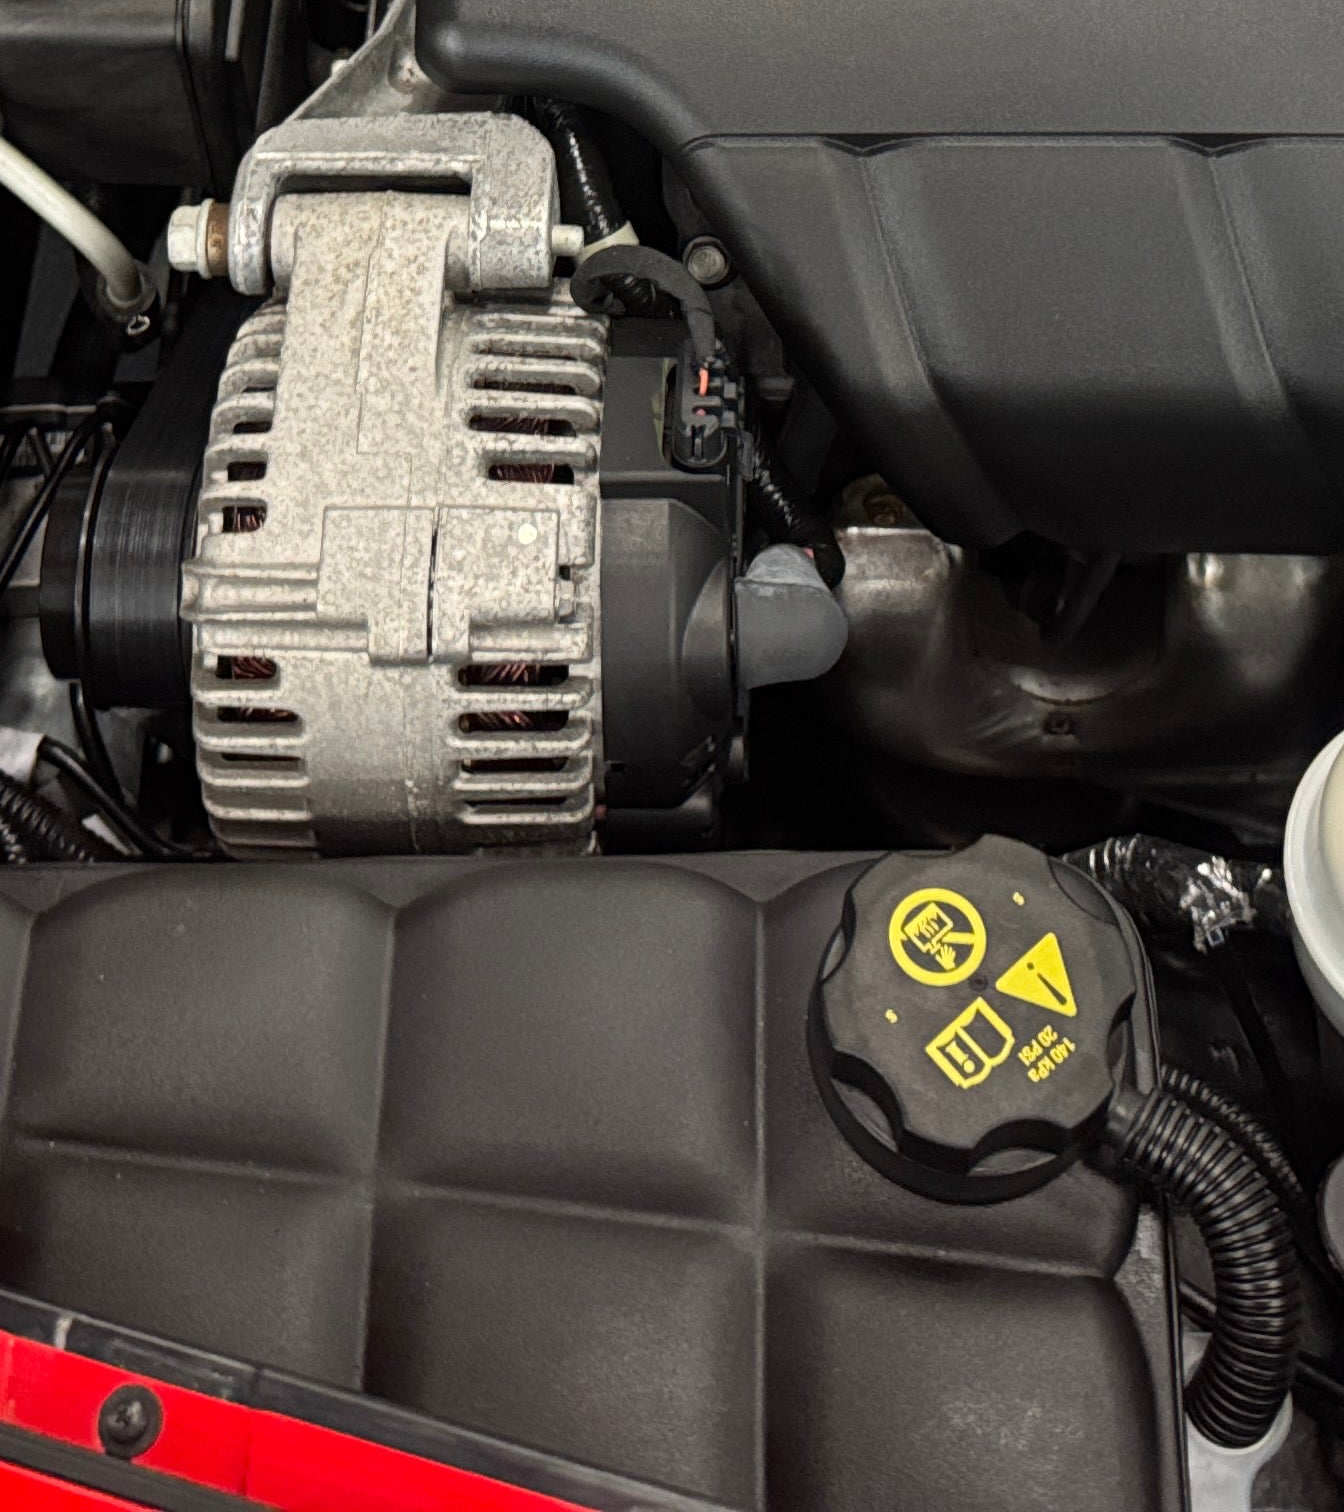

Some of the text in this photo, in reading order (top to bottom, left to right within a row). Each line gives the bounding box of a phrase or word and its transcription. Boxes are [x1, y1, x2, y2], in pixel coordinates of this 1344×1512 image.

[1018, 1024, 1058, 1066] 20 PSI
[1050, 1038, 1076, 1064] 140
